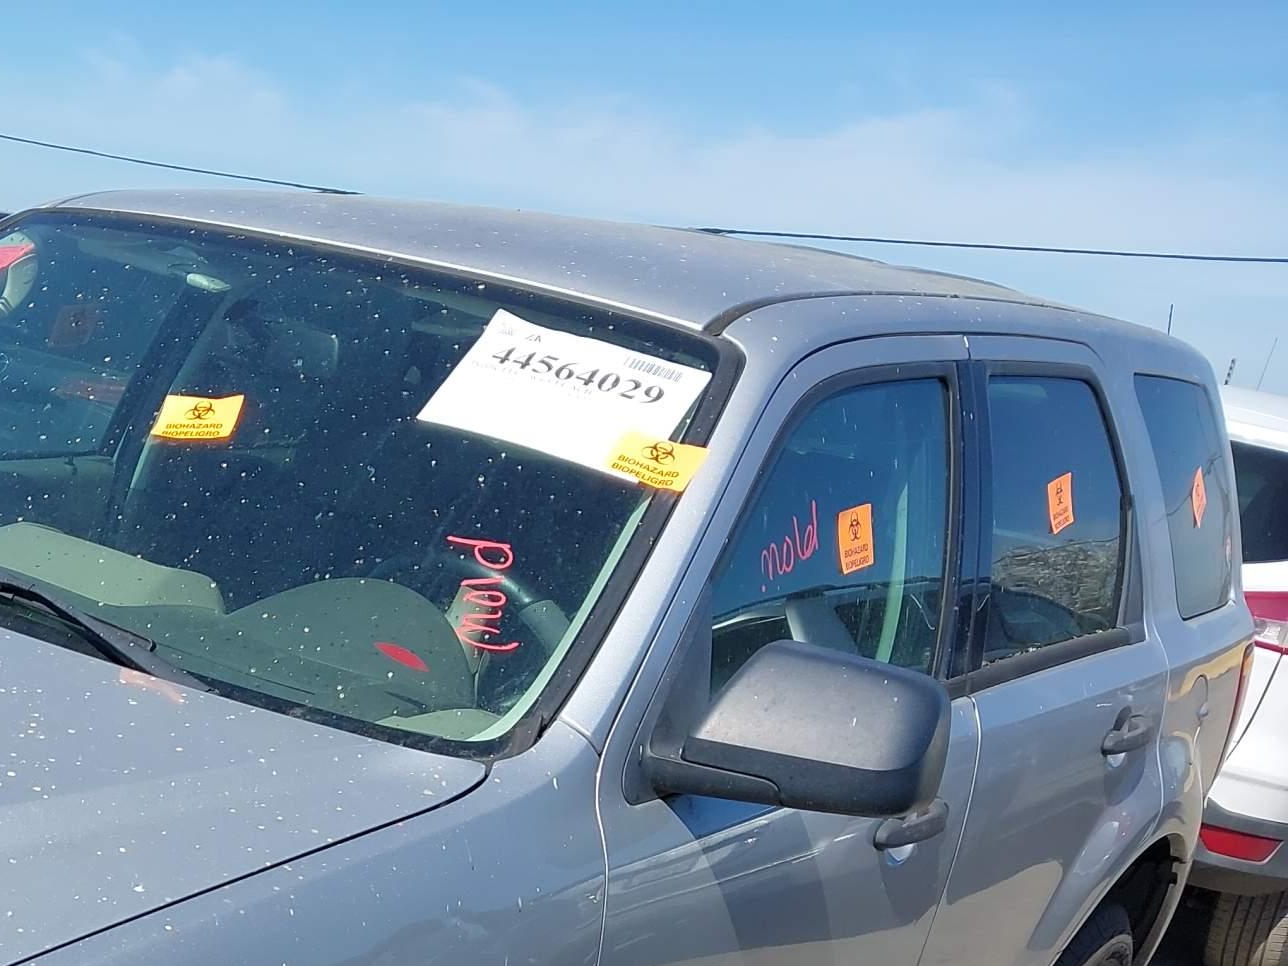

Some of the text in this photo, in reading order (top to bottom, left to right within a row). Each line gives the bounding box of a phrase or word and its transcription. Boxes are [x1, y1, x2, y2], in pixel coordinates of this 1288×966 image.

[491, 346, 665, 404] 44564029
[611, 462, 674, 487] BIOPELIGRO
[617, 454, 680, 478] BIOHAZARD
